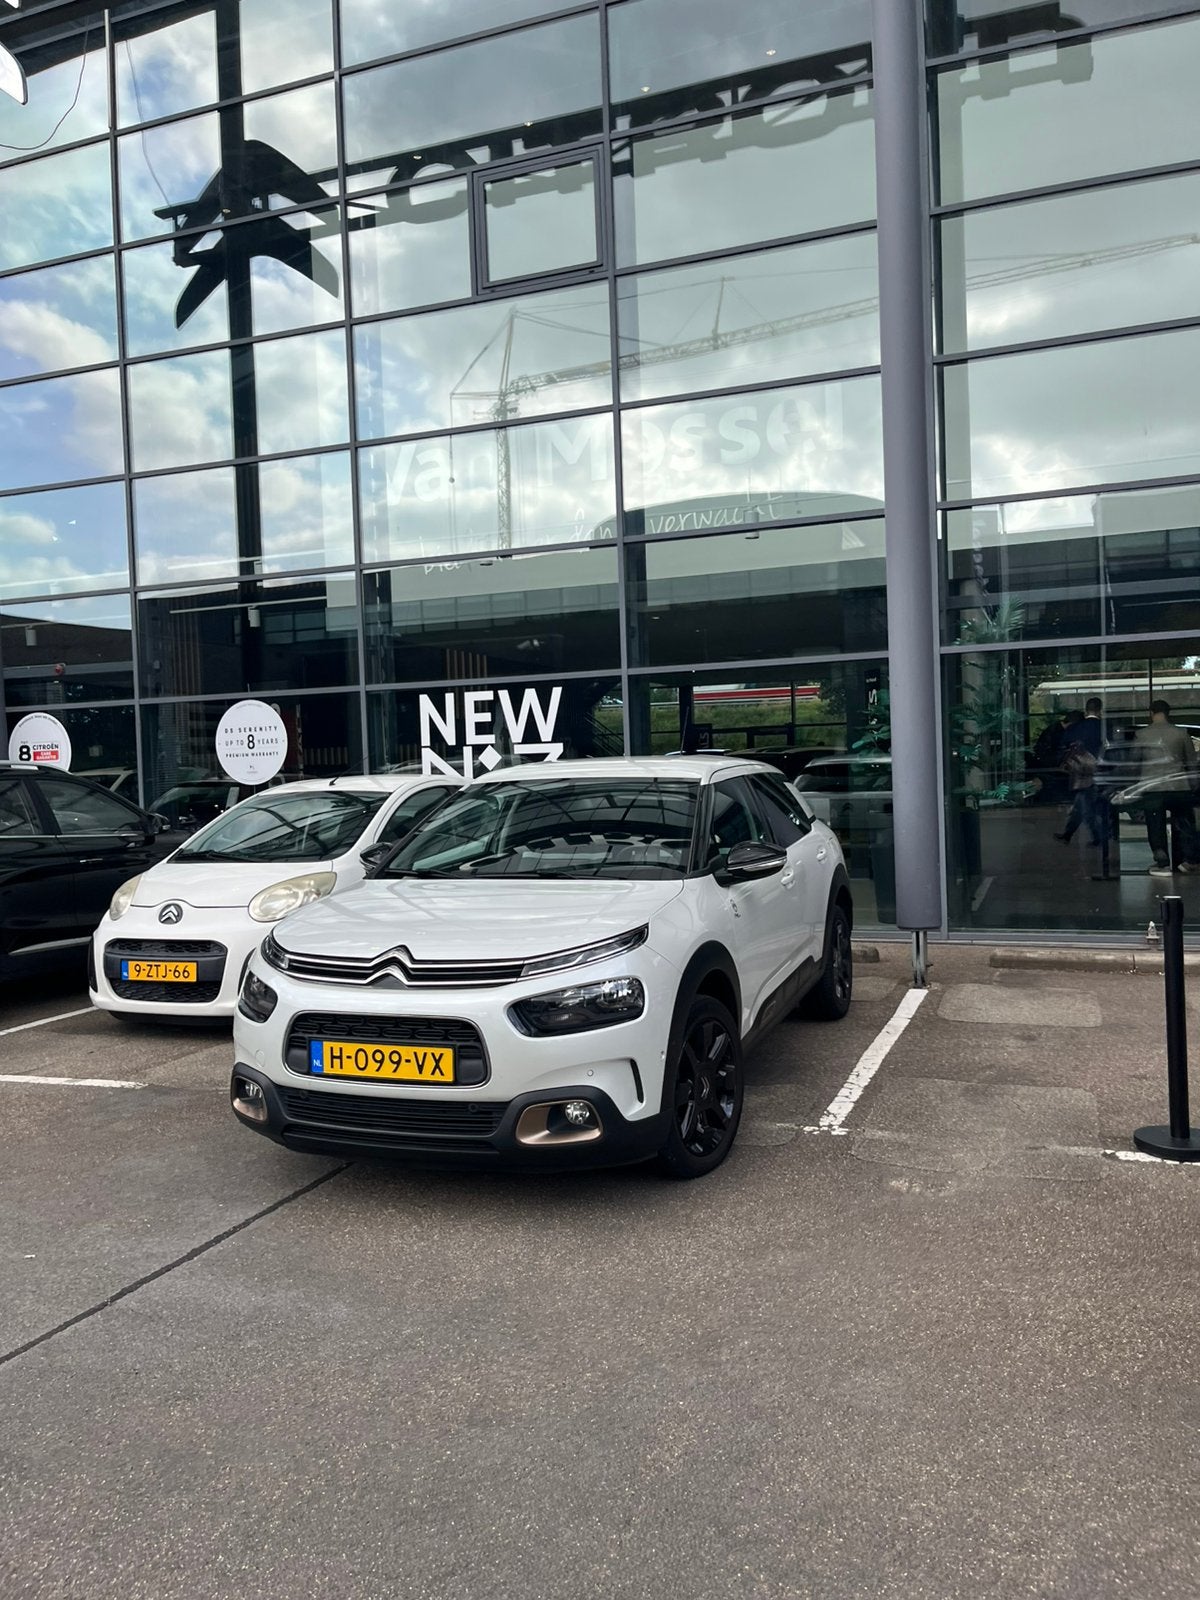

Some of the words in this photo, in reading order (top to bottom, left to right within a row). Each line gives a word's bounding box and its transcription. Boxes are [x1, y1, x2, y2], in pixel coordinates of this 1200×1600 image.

[419, 686, 563, 747] NEW
[238, 725, 278, 733] SERENITY
[225, 739, 234, 747] UP
[247, 733, 256, 750] 8
[19, 744, 32, 762] 8
[134, 963, 190, 979] 9-ZTJ-66
[313, 1059, 322, 1067] NL
[330, 1046, 445, 1077] H-099-VX
